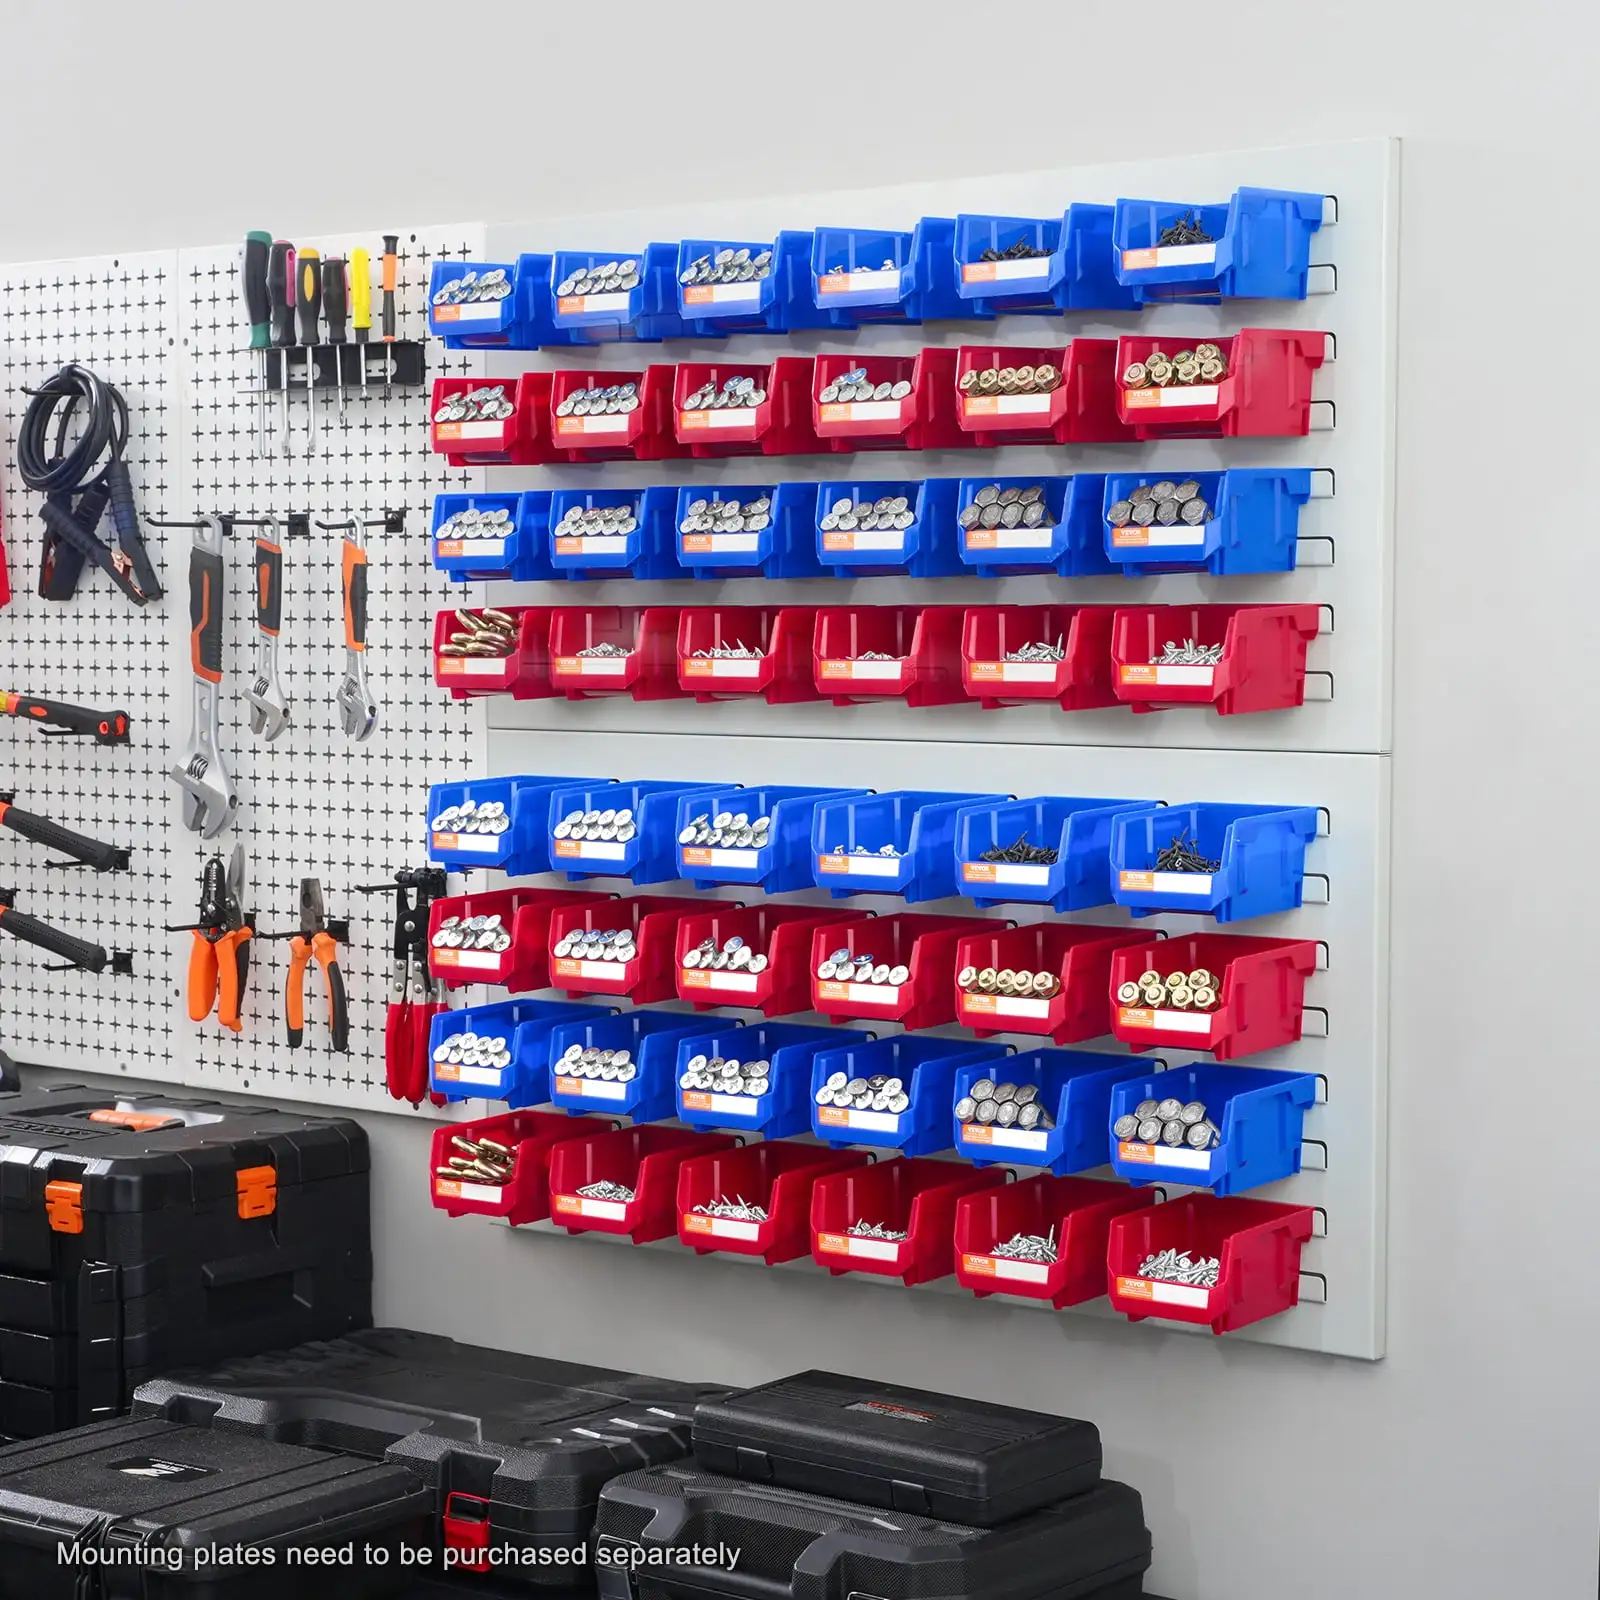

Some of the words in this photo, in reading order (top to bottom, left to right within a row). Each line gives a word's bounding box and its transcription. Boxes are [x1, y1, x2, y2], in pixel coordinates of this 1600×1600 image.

[968, 1126, 986, 1134] VEVOR
[1127, 1145, 1147, 1153] VEVOR
[970, 1257, 988, 1265] VEVOR
[1125, 1279, 1145, 1288] VEVOR
